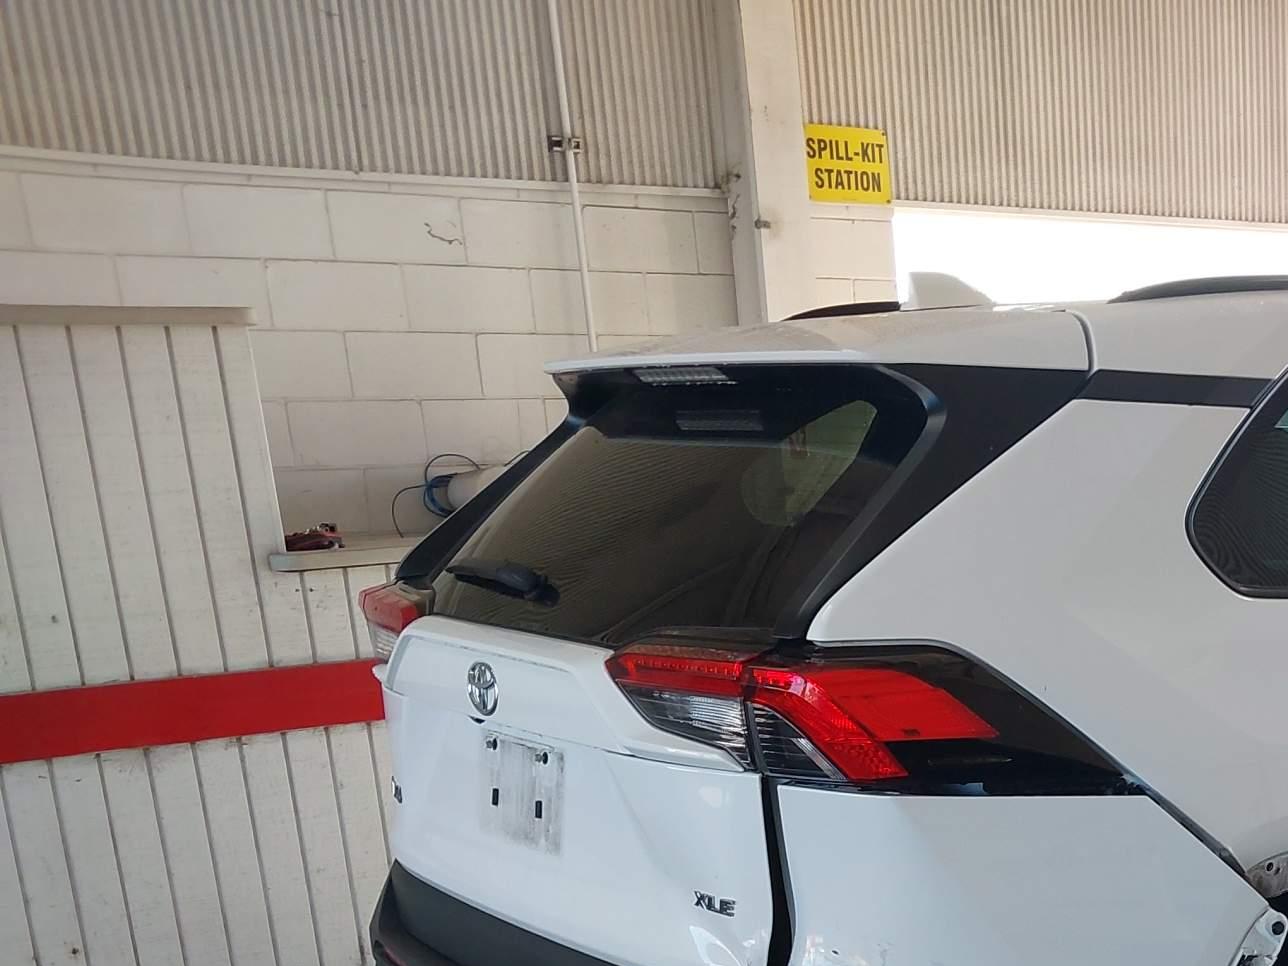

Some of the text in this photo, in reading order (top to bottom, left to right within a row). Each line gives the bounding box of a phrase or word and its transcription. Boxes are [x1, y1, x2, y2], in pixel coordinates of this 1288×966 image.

[805, 137, 884, 163] SPILL-KIT
[814, 168, 882, 193] STATION
[693, 890, 737, 918] XLE
